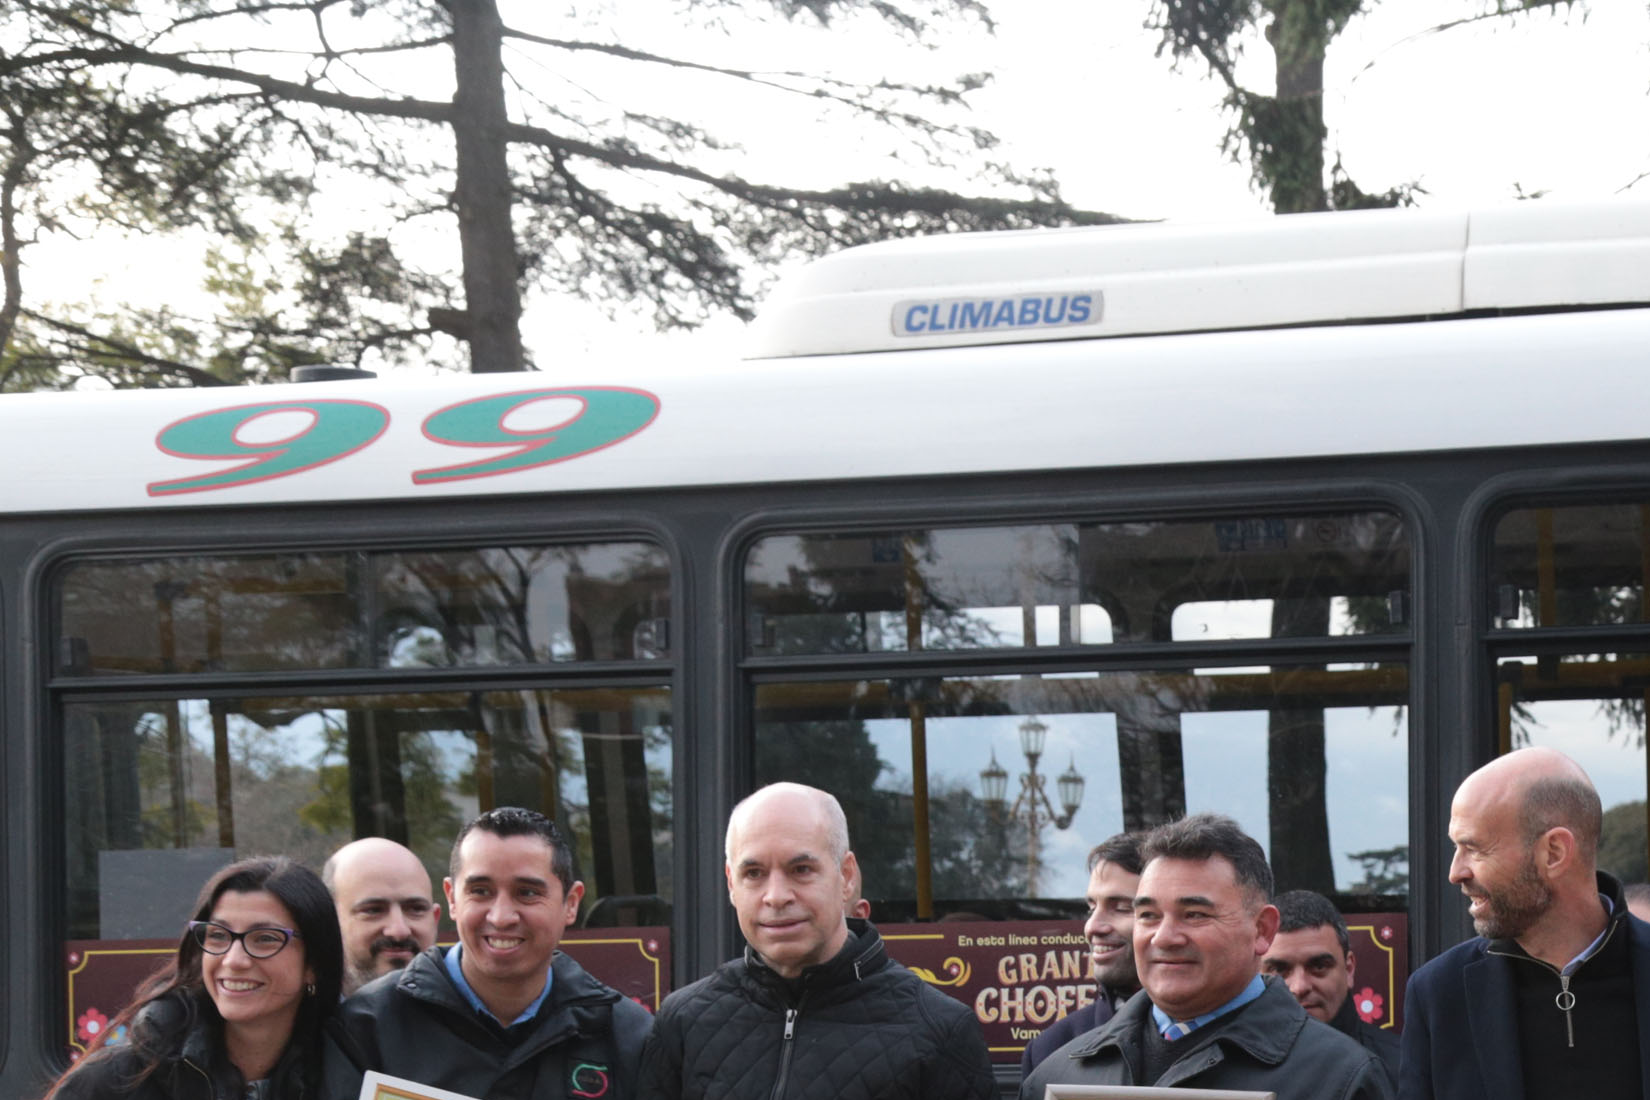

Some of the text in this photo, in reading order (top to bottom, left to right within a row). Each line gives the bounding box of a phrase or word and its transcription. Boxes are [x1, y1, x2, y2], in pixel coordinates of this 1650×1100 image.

[904, 295, 1092, 332] CLIMABUS
[146, 385, 662, 497] 99
[958, 935, 974, 946] En
[977, 936, 1005, 946] esta
[1009, 934, 1037, 945] línea
[1010, 1027, 1044, 1040] Vam
